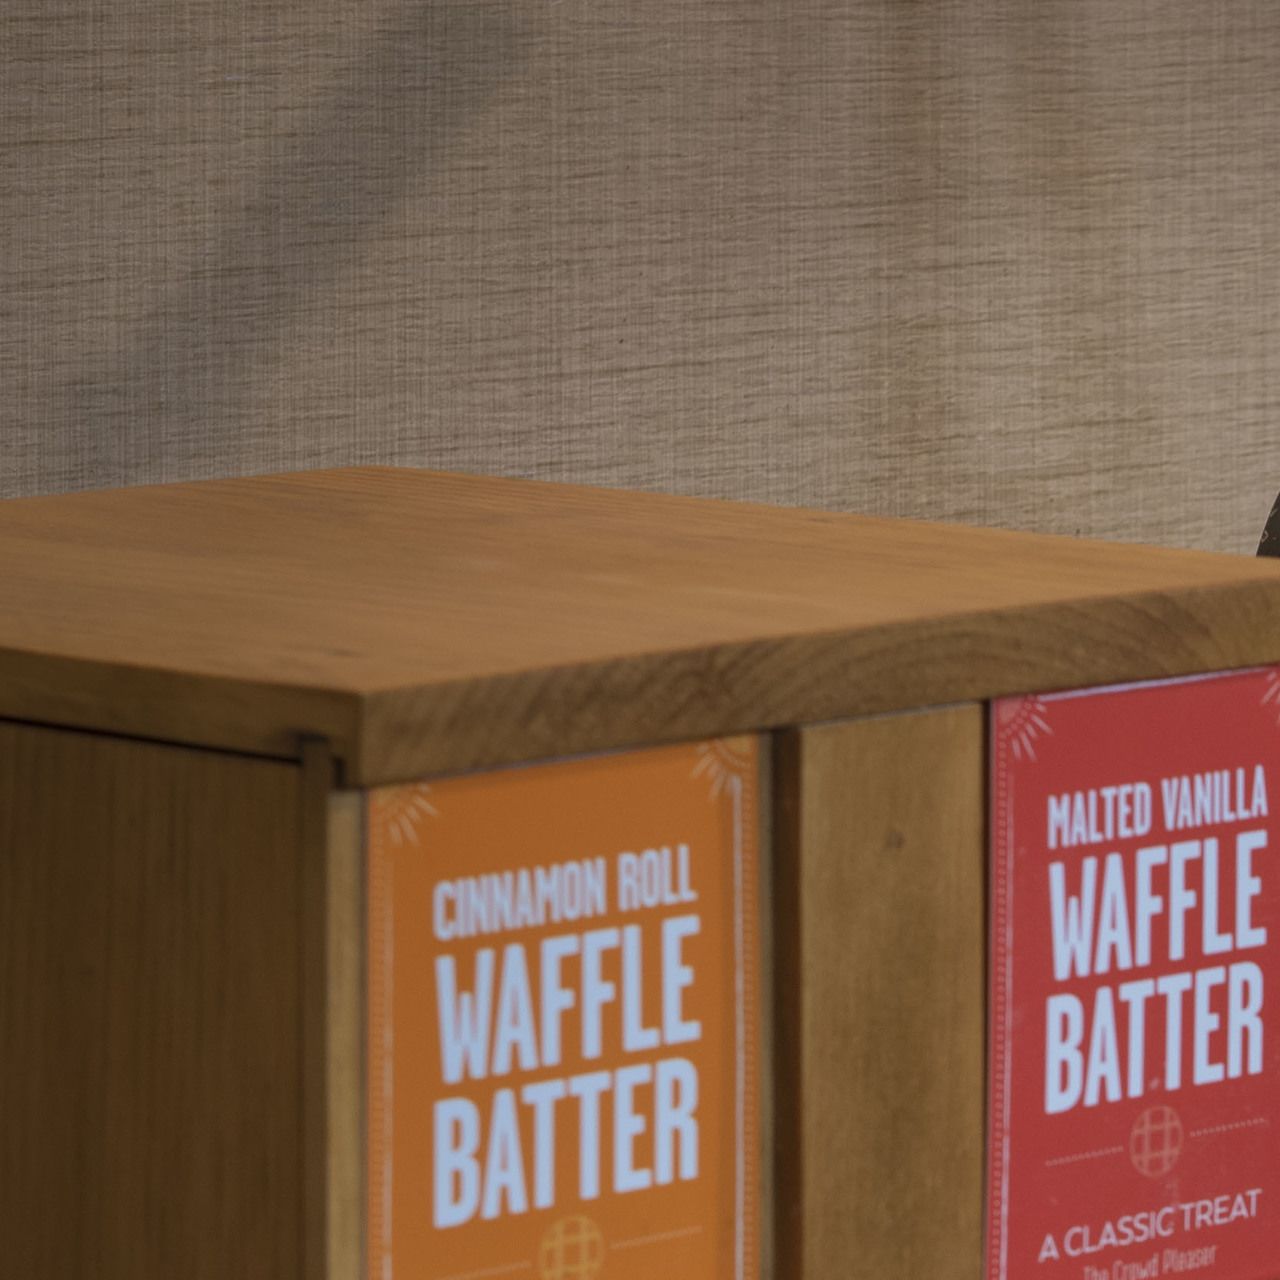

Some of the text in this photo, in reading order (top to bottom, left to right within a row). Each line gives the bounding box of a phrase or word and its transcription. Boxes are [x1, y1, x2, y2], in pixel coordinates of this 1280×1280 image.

[1048, 764, 1268, 849] MALTED VANILLA
[432, 844, 697, 940] CINNAMON ROLL
[1049, 829, 1267, 982] WAFFLE
[435, 914, 701, 1084] WAFFLE
[1045, 961, 1263, 1115] BATTER
[432, 1057, 699, 1230] BATTER
[1037, 1188, 1262, 1263] A CLASSIC TREAT
[1163, 1245, 1217, 1273] Pleaser
